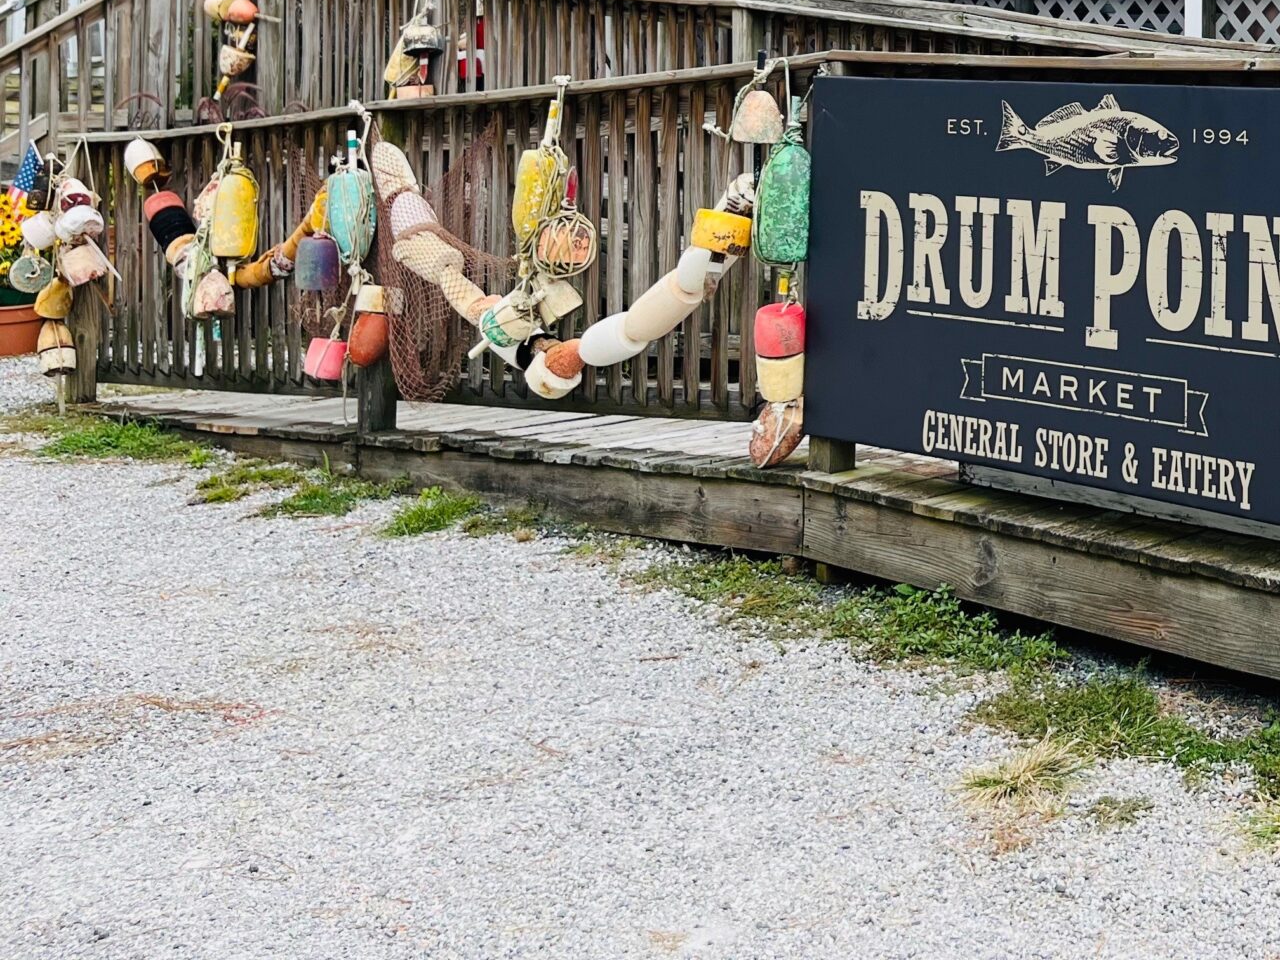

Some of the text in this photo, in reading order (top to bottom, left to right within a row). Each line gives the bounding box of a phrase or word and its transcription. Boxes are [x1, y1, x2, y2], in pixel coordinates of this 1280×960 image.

[946, 118, 1250, 146] EST. 1994
[856, 189, 1067, 322] DRUM
[1001, 366, 1163, 414] MARKET
[922, 409, 1256, 511] GENERAL STORE & EATERY
